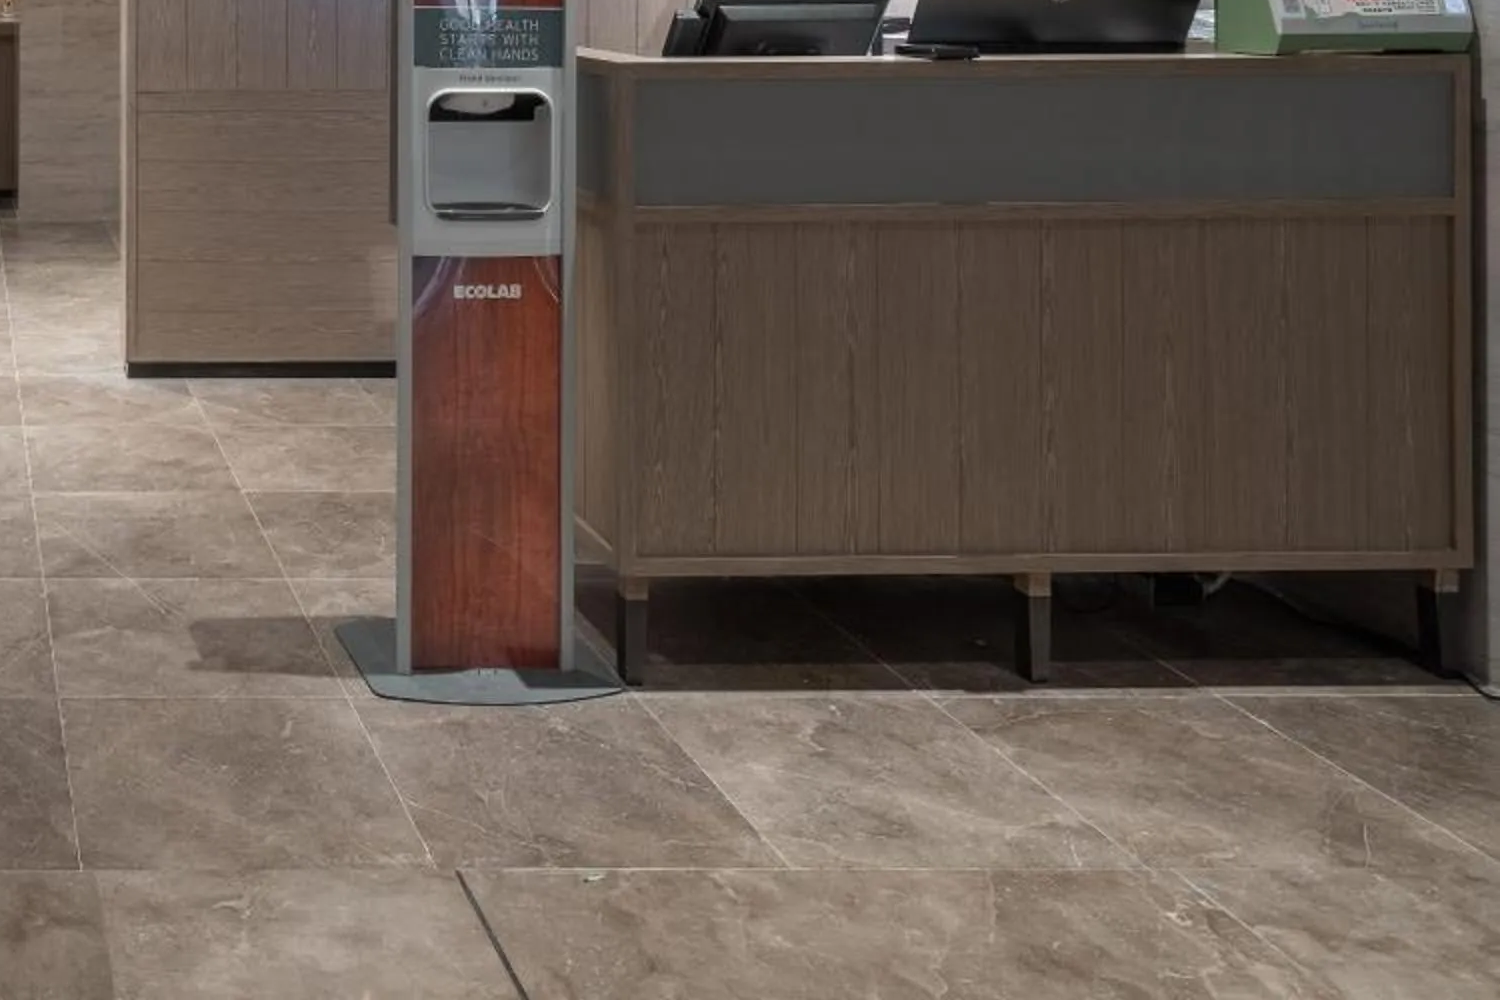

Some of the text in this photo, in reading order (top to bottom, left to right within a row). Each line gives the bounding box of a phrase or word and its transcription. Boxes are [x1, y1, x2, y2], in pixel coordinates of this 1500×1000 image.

[502, 33, 539, 45] WITH
[439, 47, 539, 60] CLEAN HANDS
[453, 284, 521, 299] ECOLAB
